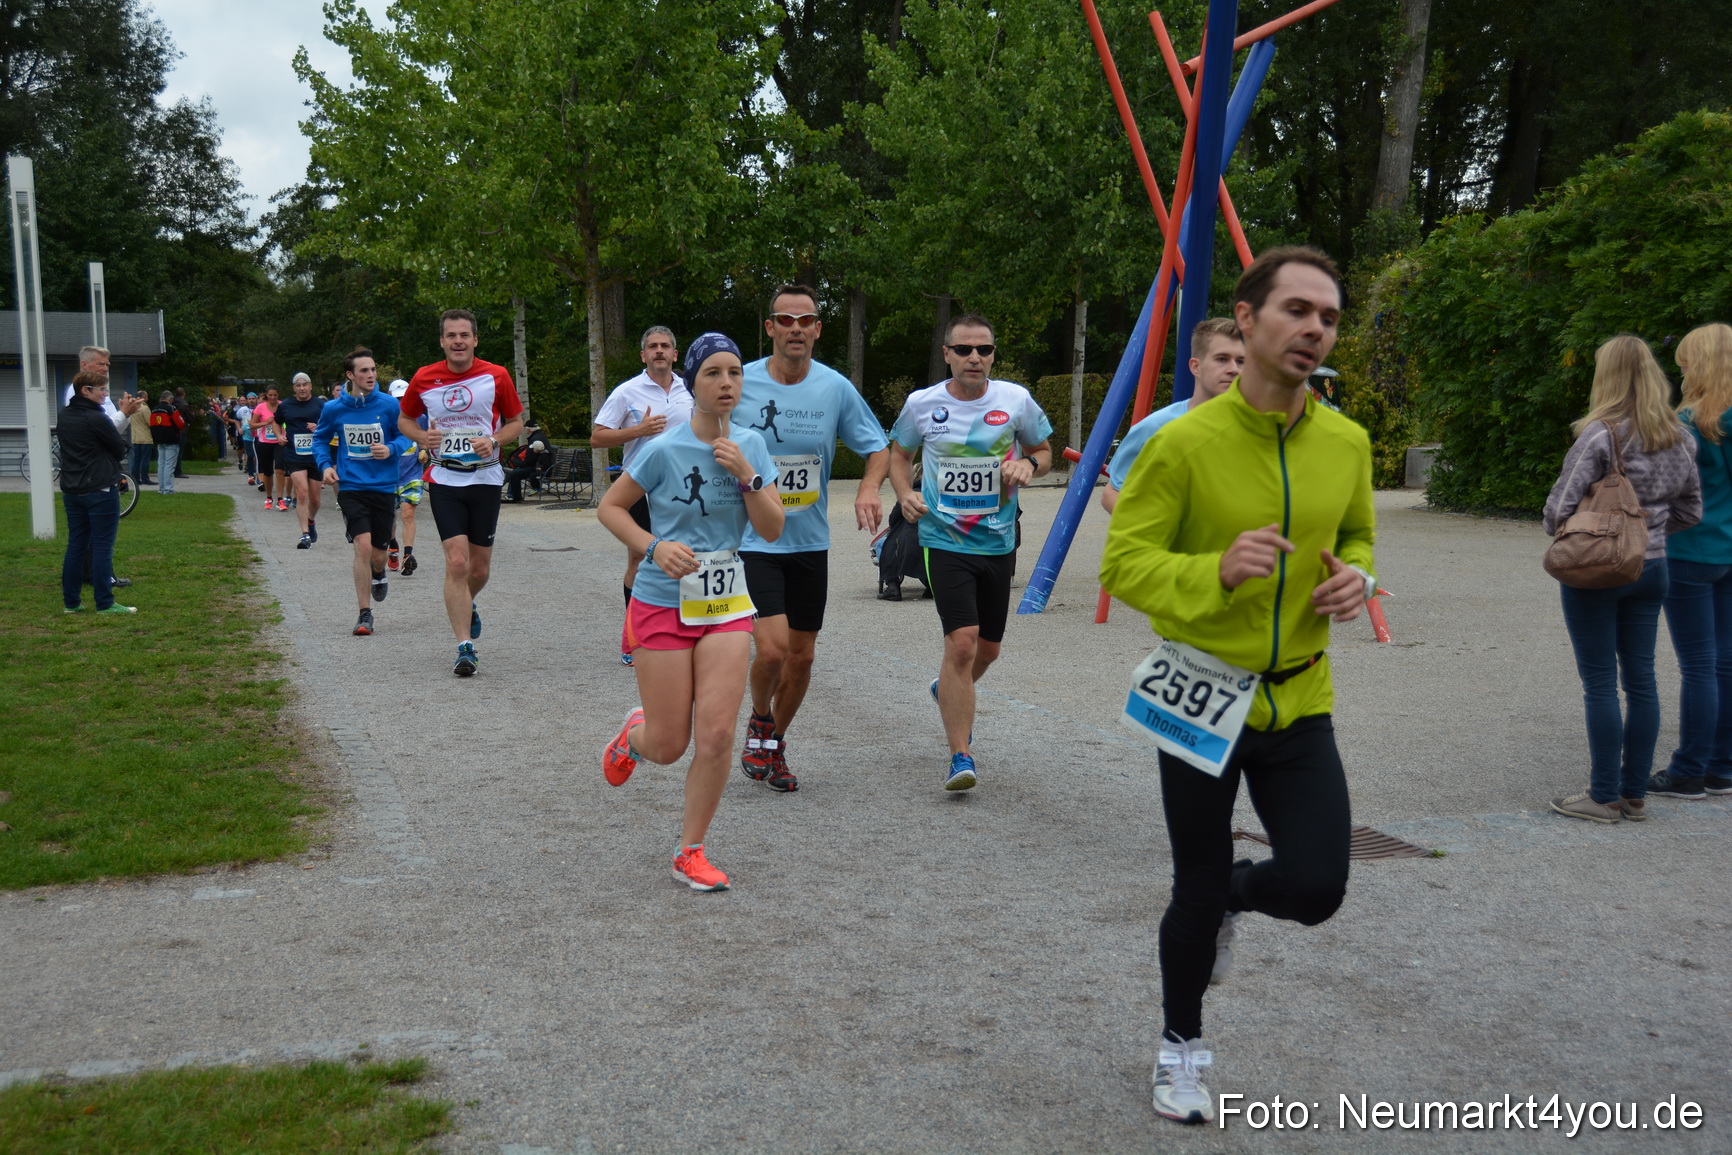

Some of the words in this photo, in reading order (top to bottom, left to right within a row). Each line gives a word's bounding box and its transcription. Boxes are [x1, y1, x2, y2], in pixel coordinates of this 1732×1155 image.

[785, 409, 808, 419] GYM
[811, 411, 825, 420] HIP
[783, 428, 824, 436] Halbmarathon
[297, 439, 312, 447] 222
[348, 432, 380, 445] 2409
[444, 438, 471, 453] 246
[712, 477, 736, 487] GYM
[944, 471, 993, 493] 2391
[780, 496, 800, 505] efan
[952, 498, 986, 508] Stephan
[698, 567, 735, 596] 137
[706, 603, 729, 614] Alena
[1161, 643, 1181, 662] ARTL
[1182, 656, 1234, 685] Neumarkt
[1139, 659, 1238, 727] 2597
[1145, 707, 1198, 748] Thomas
